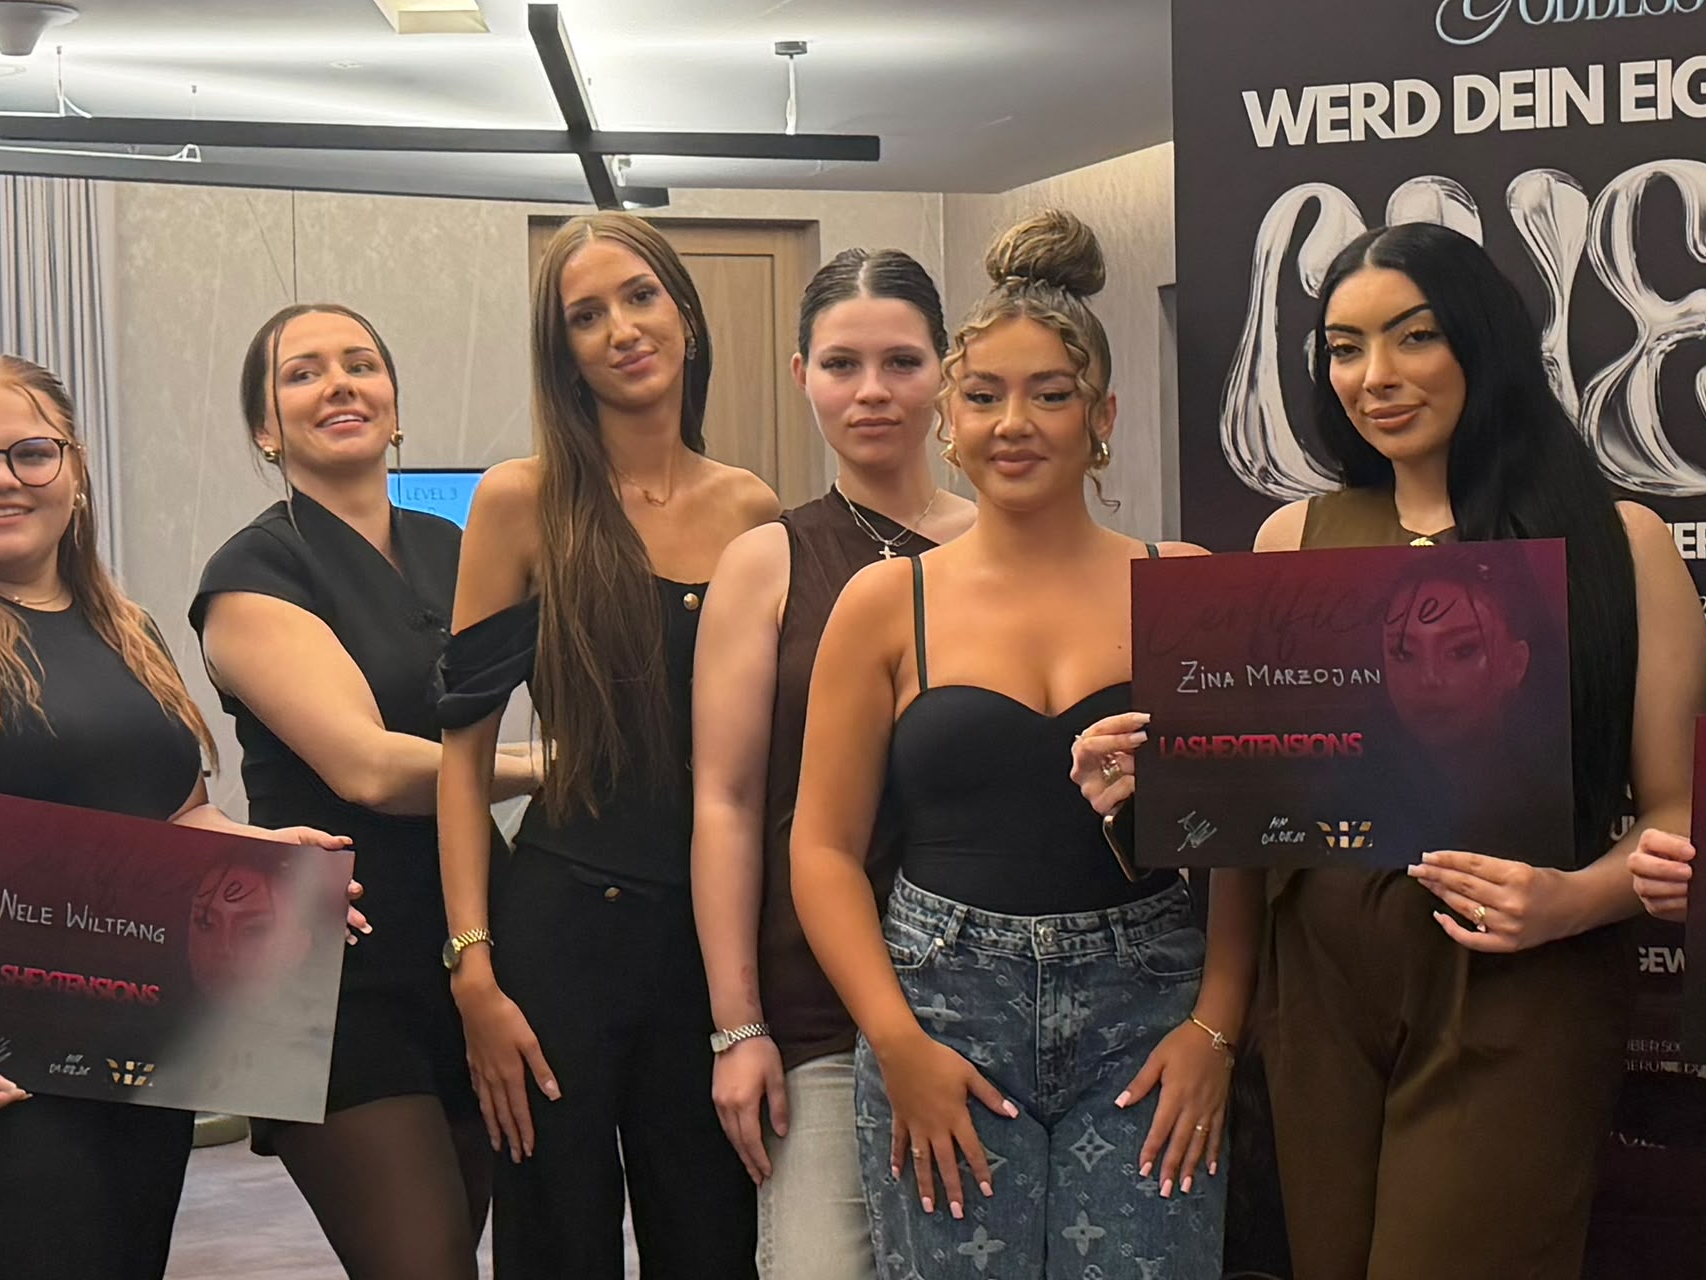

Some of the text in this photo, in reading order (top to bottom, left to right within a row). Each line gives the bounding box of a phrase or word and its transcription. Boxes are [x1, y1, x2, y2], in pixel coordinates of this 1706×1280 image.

[1242, 79, 1441, 148] WERD
[1453, 65, 1604, 134] DEIN
[1246, 664, 1381, 687] MARZOJAN
[1159, 732, 1364, 758] LASHEXTENSIONS
[0, 888, 53, 925] NELE
